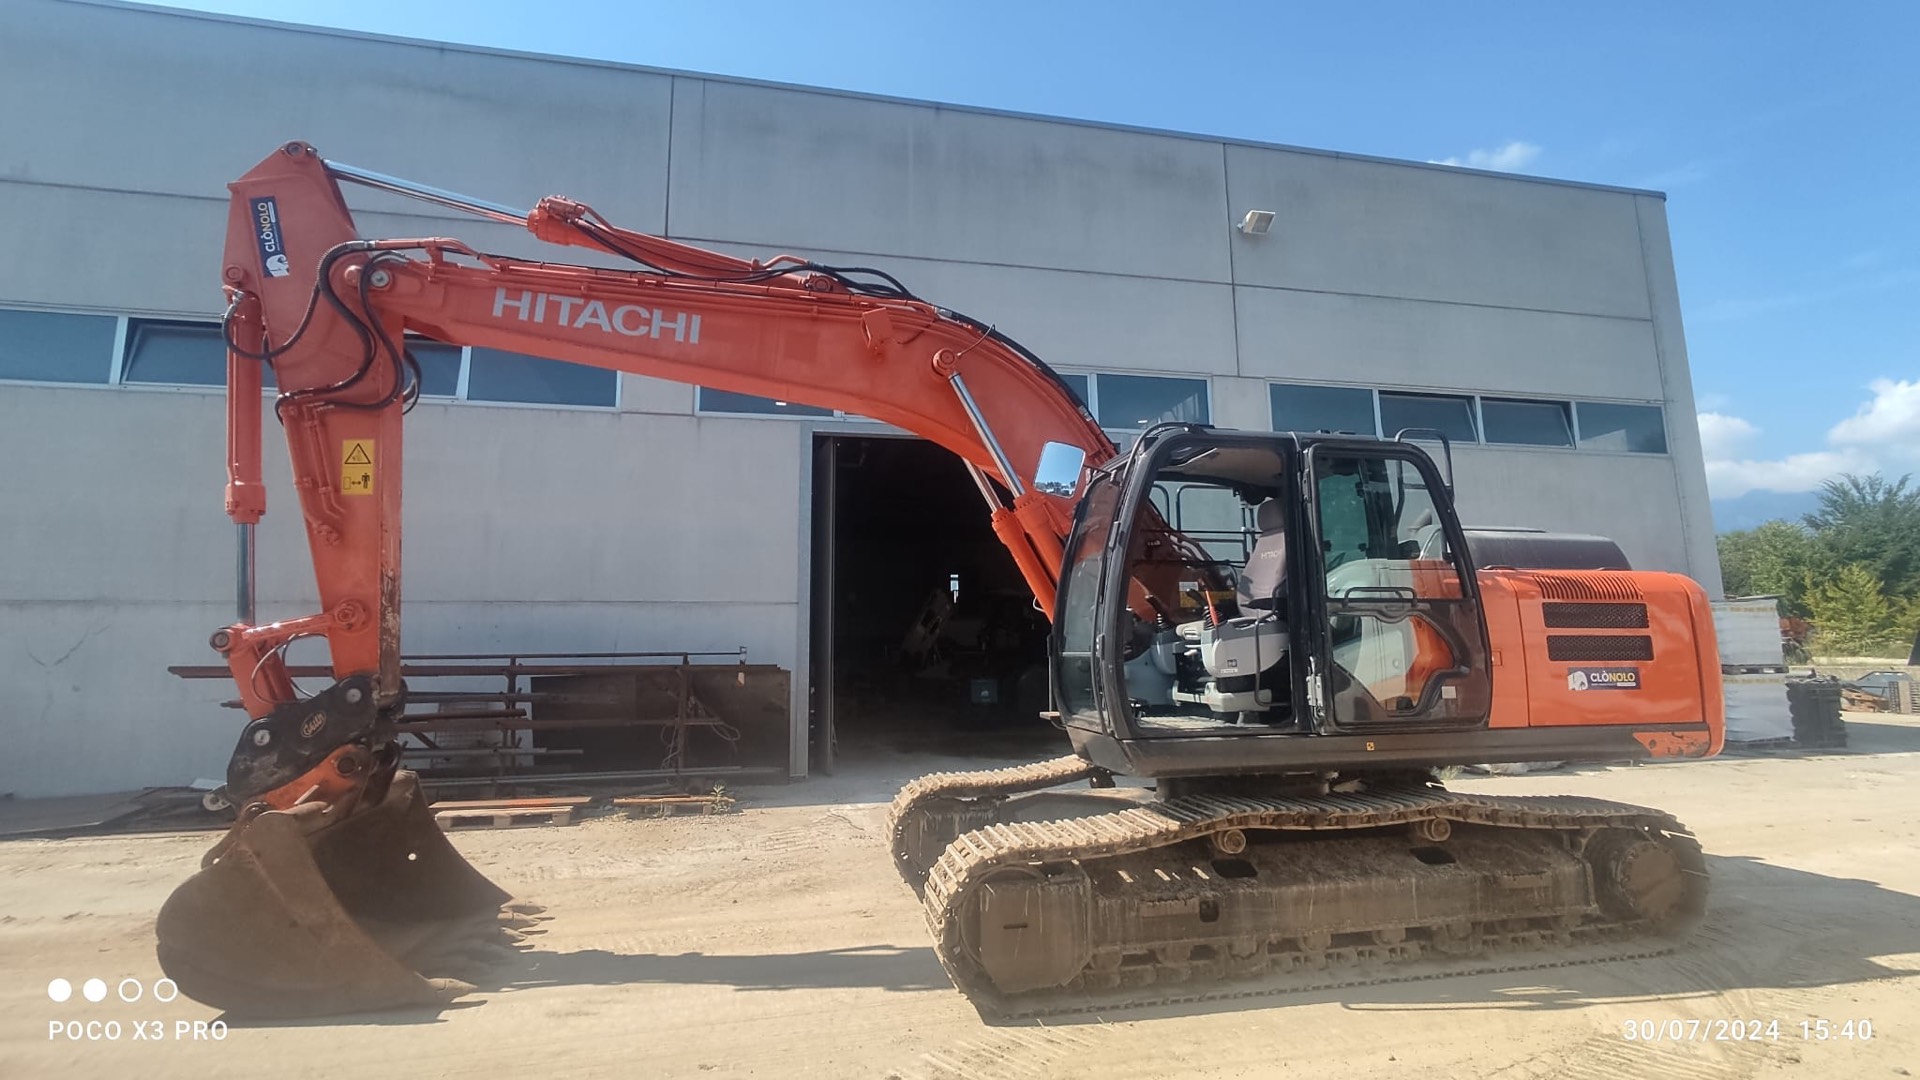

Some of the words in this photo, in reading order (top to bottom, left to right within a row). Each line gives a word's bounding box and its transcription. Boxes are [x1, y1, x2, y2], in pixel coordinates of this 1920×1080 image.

[257, 202, 276, 252] CLÒNOLO
[492, 287, 702, 344] HITACHI
[1590, 670, 1636, 682] CLÒNOLO
